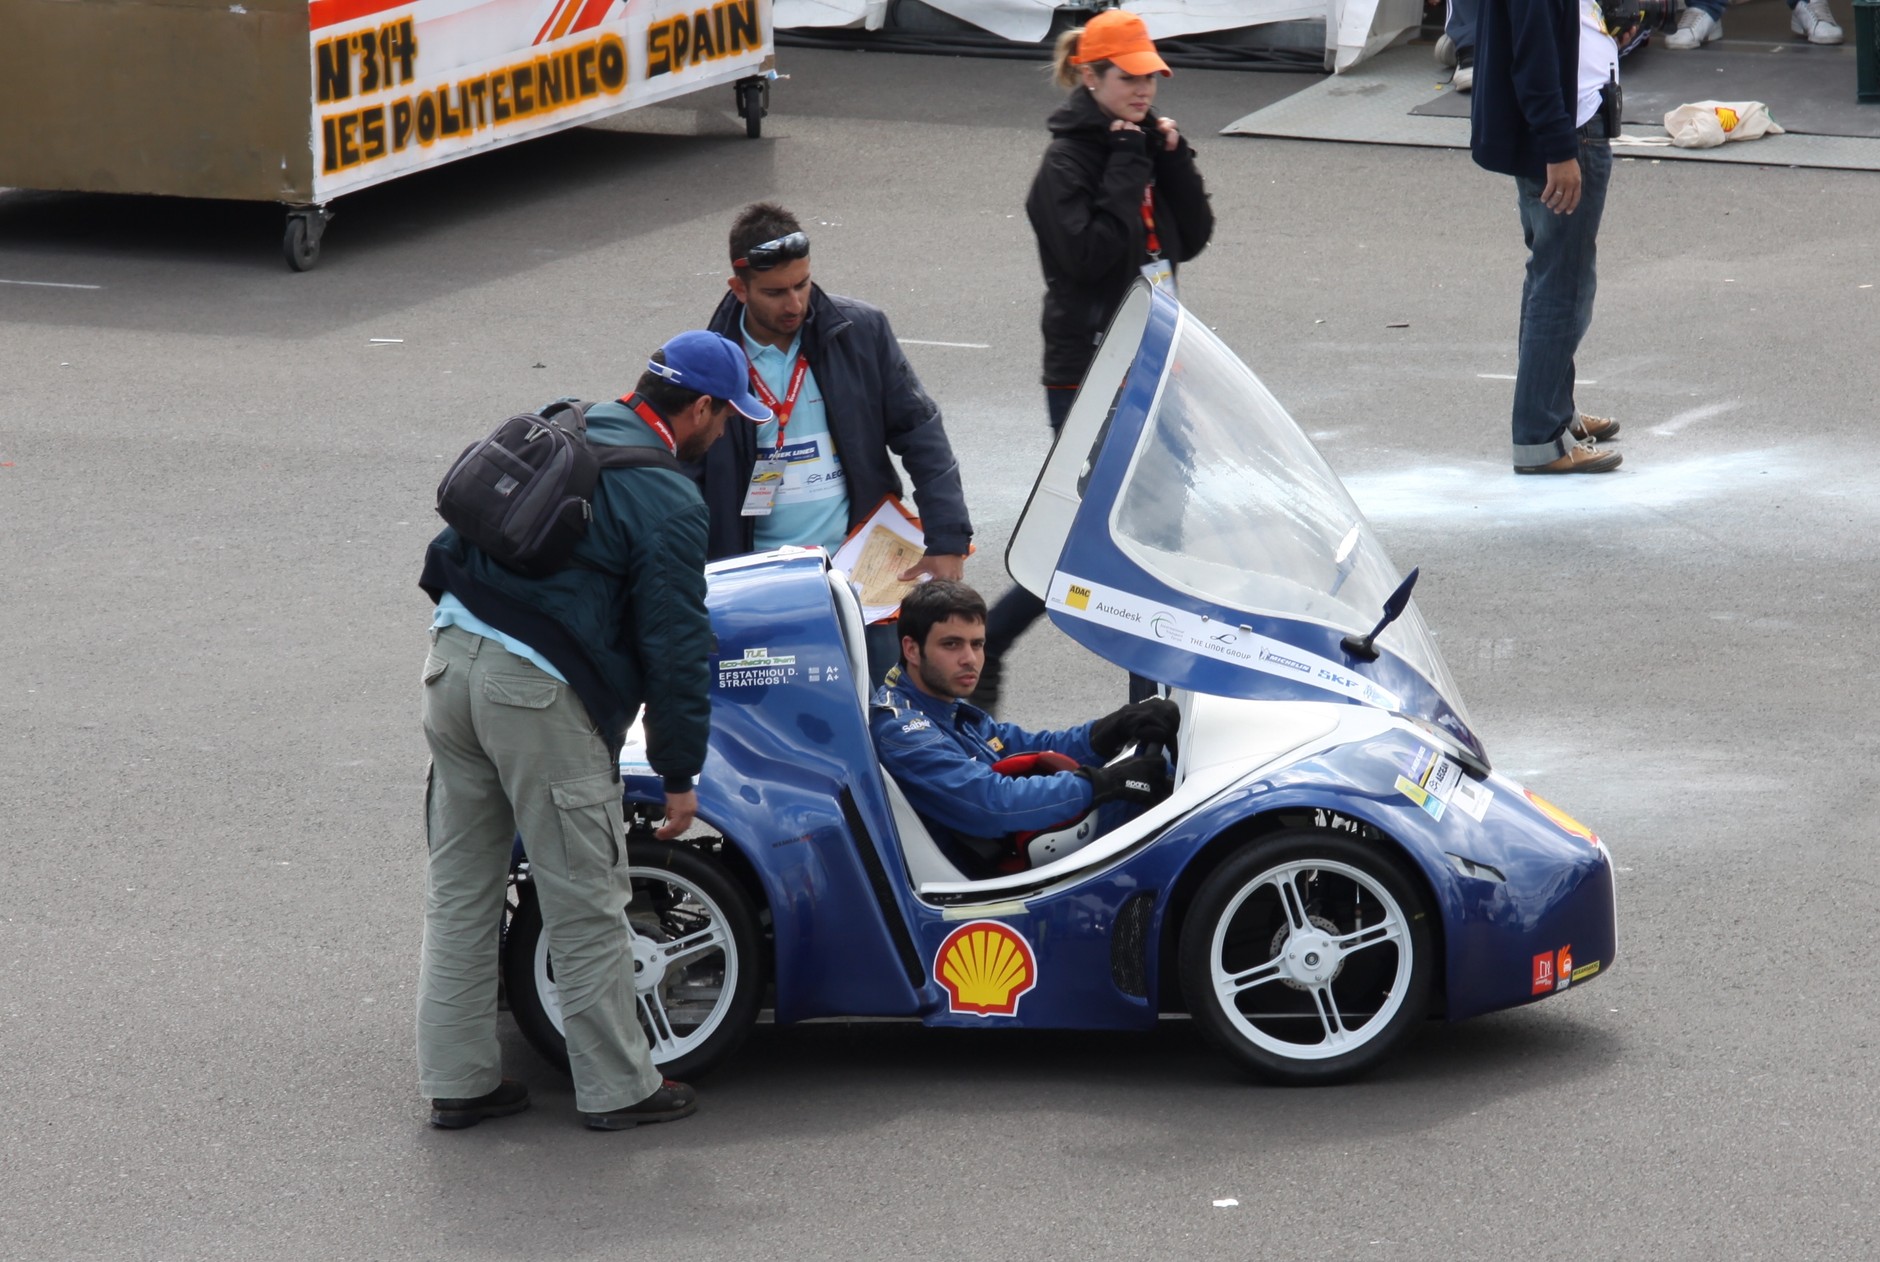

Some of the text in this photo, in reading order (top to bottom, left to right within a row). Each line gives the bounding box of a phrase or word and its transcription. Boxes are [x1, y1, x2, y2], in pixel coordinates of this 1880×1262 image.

[322, 104, 388, 175] IES
[645, 0, 762, 79] SPAIN
[1069, 584, 1091, 598] ADAC
[1096, 602, 1142, 623] Autodesk
[745, 649, 766, 658] TUC
[1190, 638, 1203, 647] THE
[1225, 648, 1251, 660] GROUP
[826, 666, 839, 674] A+
[1269, 654, 1310, 672] MICHELIN
[719, 668, 799, 680] EFSTATHIOU D.
[826, 674, 839, 682] A+
[1317, 669, 1359, 688] SKF
[719, 676, 790, 688] STRATIGOS I.
